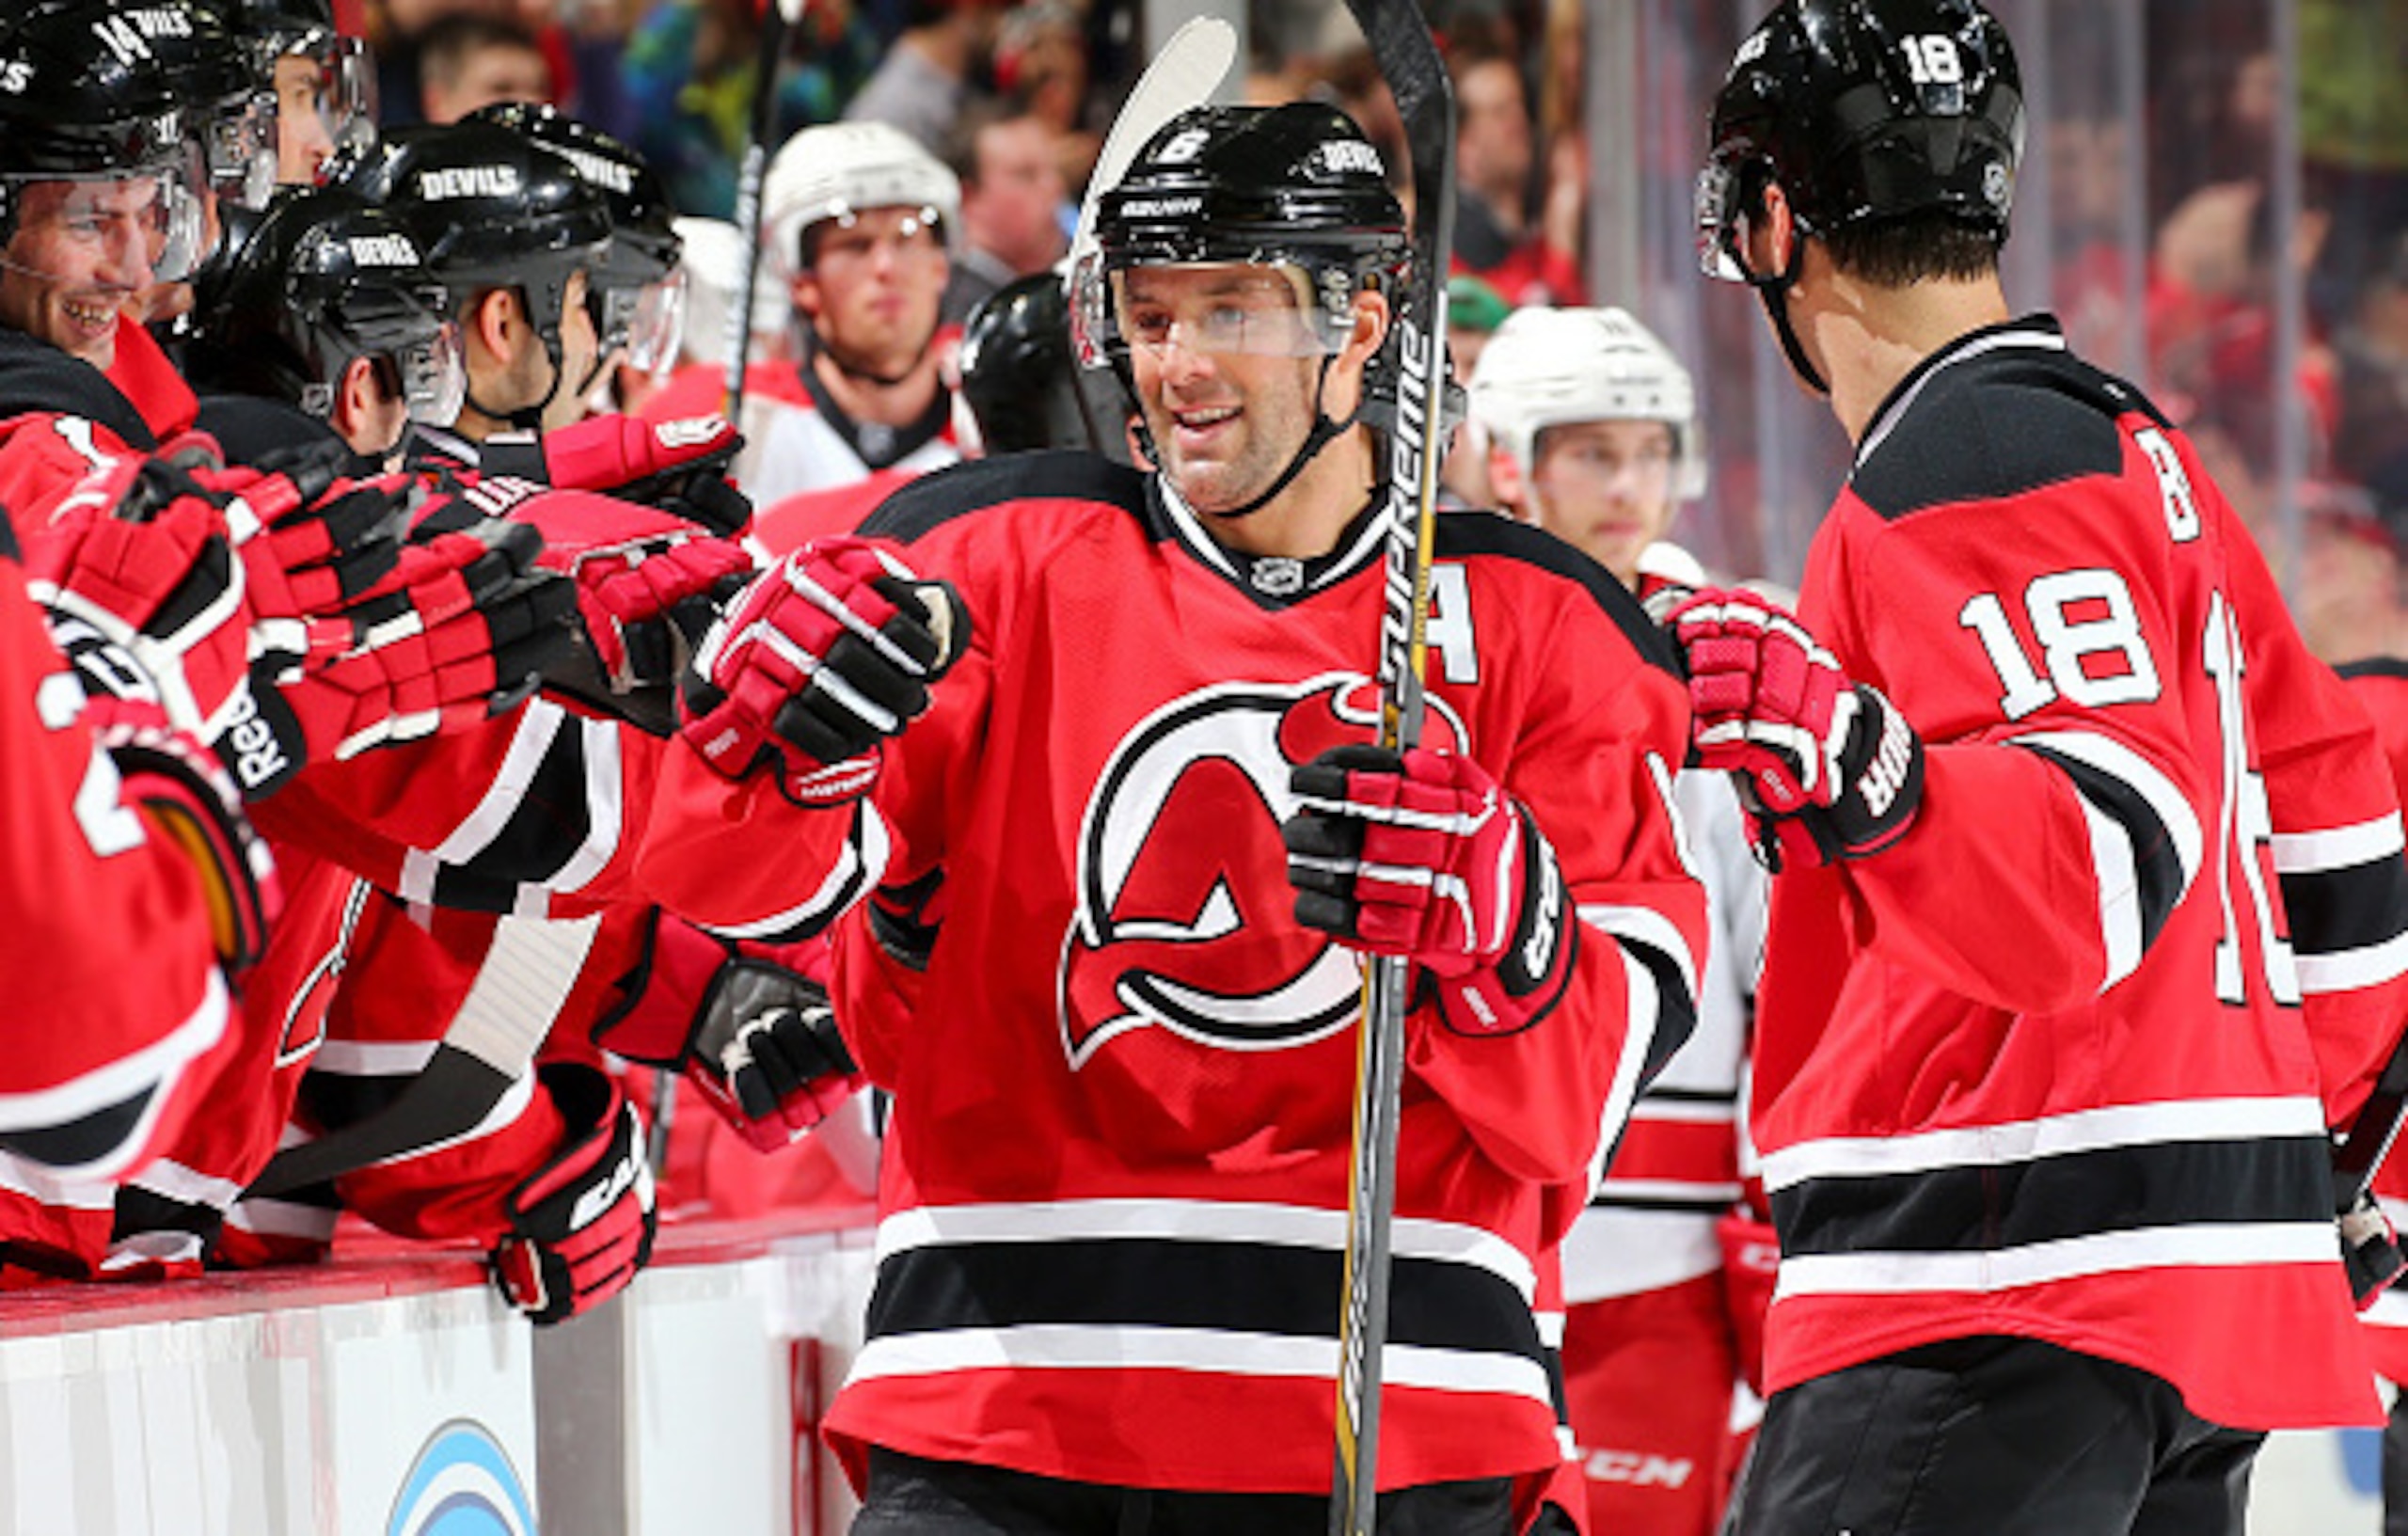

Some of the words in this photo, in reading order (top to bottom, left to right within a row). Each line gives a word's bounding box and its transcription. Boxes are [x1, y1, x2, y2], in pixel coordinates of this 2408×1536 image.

[1901, 36, 1963, 83] 18
[1154, 129, 1211, 164] 6
[421, 165, 516, 201] DEVILS
[1422, 562, 1479, 684] A
[1958, 568, 2162, 721] 18
